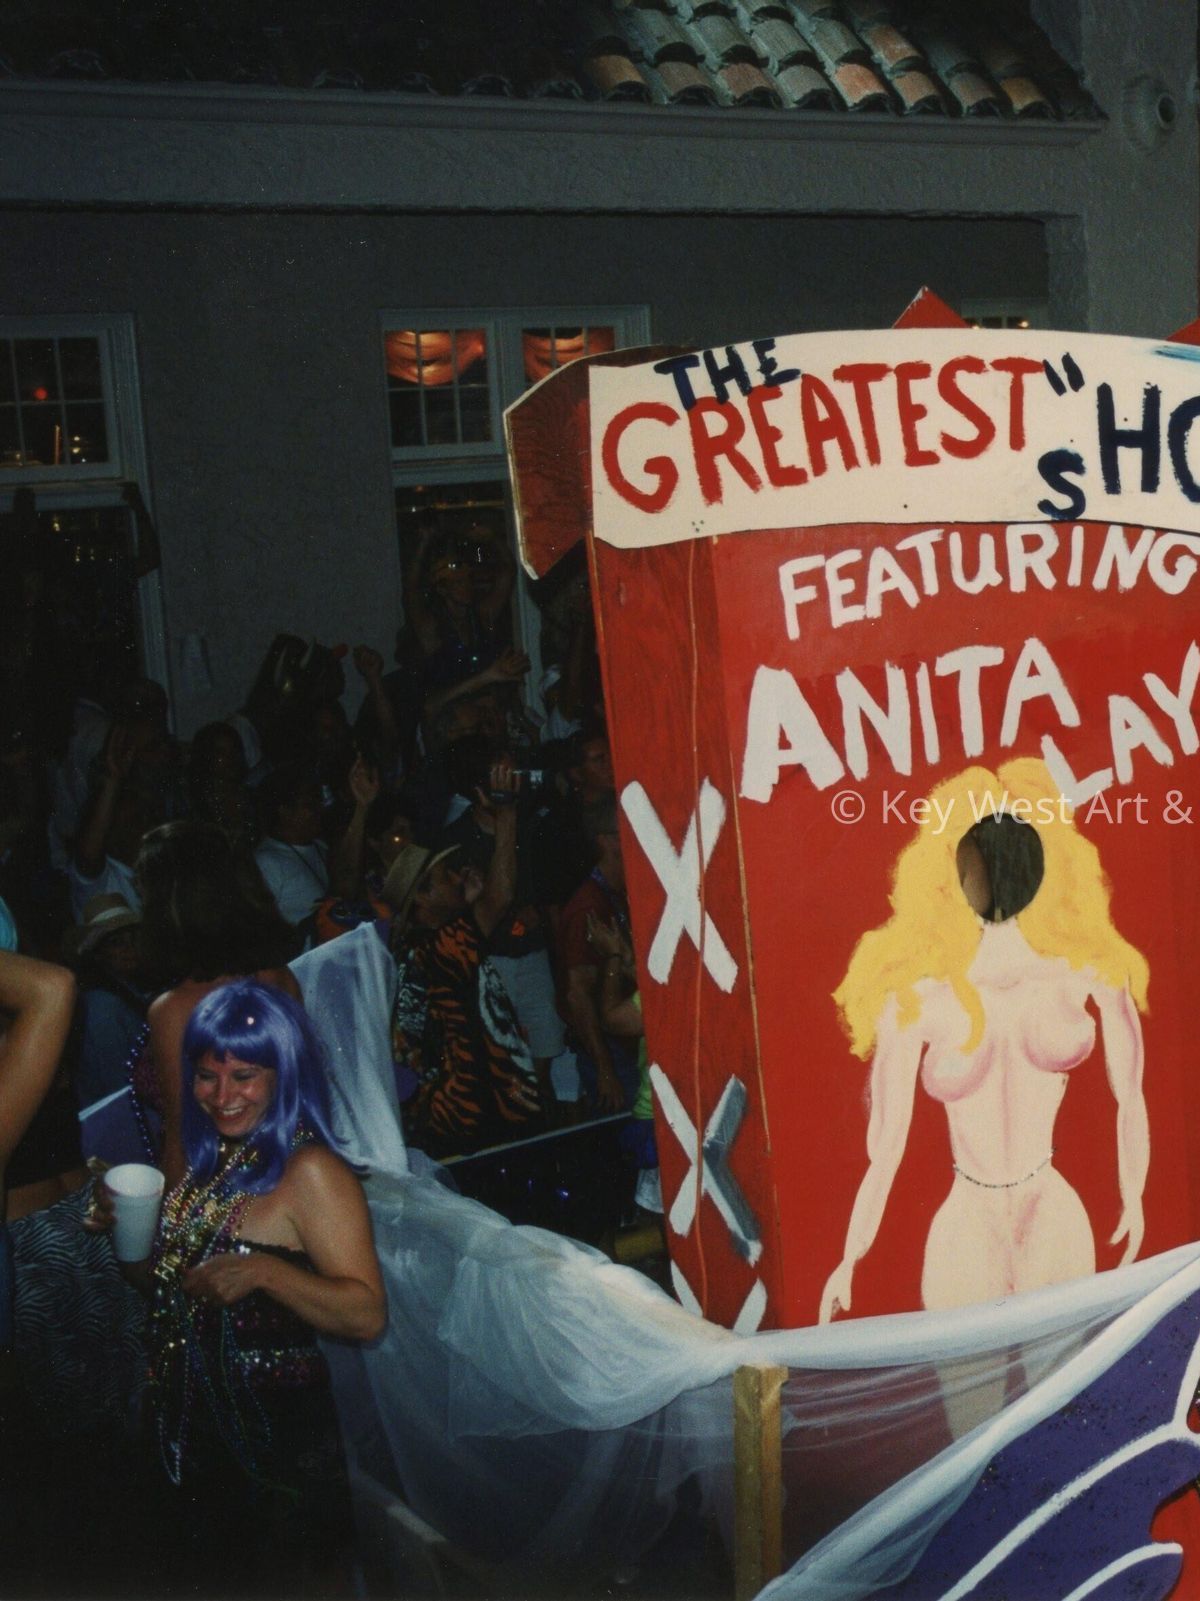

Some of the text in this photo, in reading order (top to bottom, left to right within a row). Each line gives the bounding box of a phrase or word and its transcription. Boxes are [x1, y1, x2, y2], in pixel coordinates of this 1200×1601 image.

[602, 356, 1048, 513] GREATEST
[654, 339, 801, 411] THE
[740, 637, 1082, 803] ANITA
